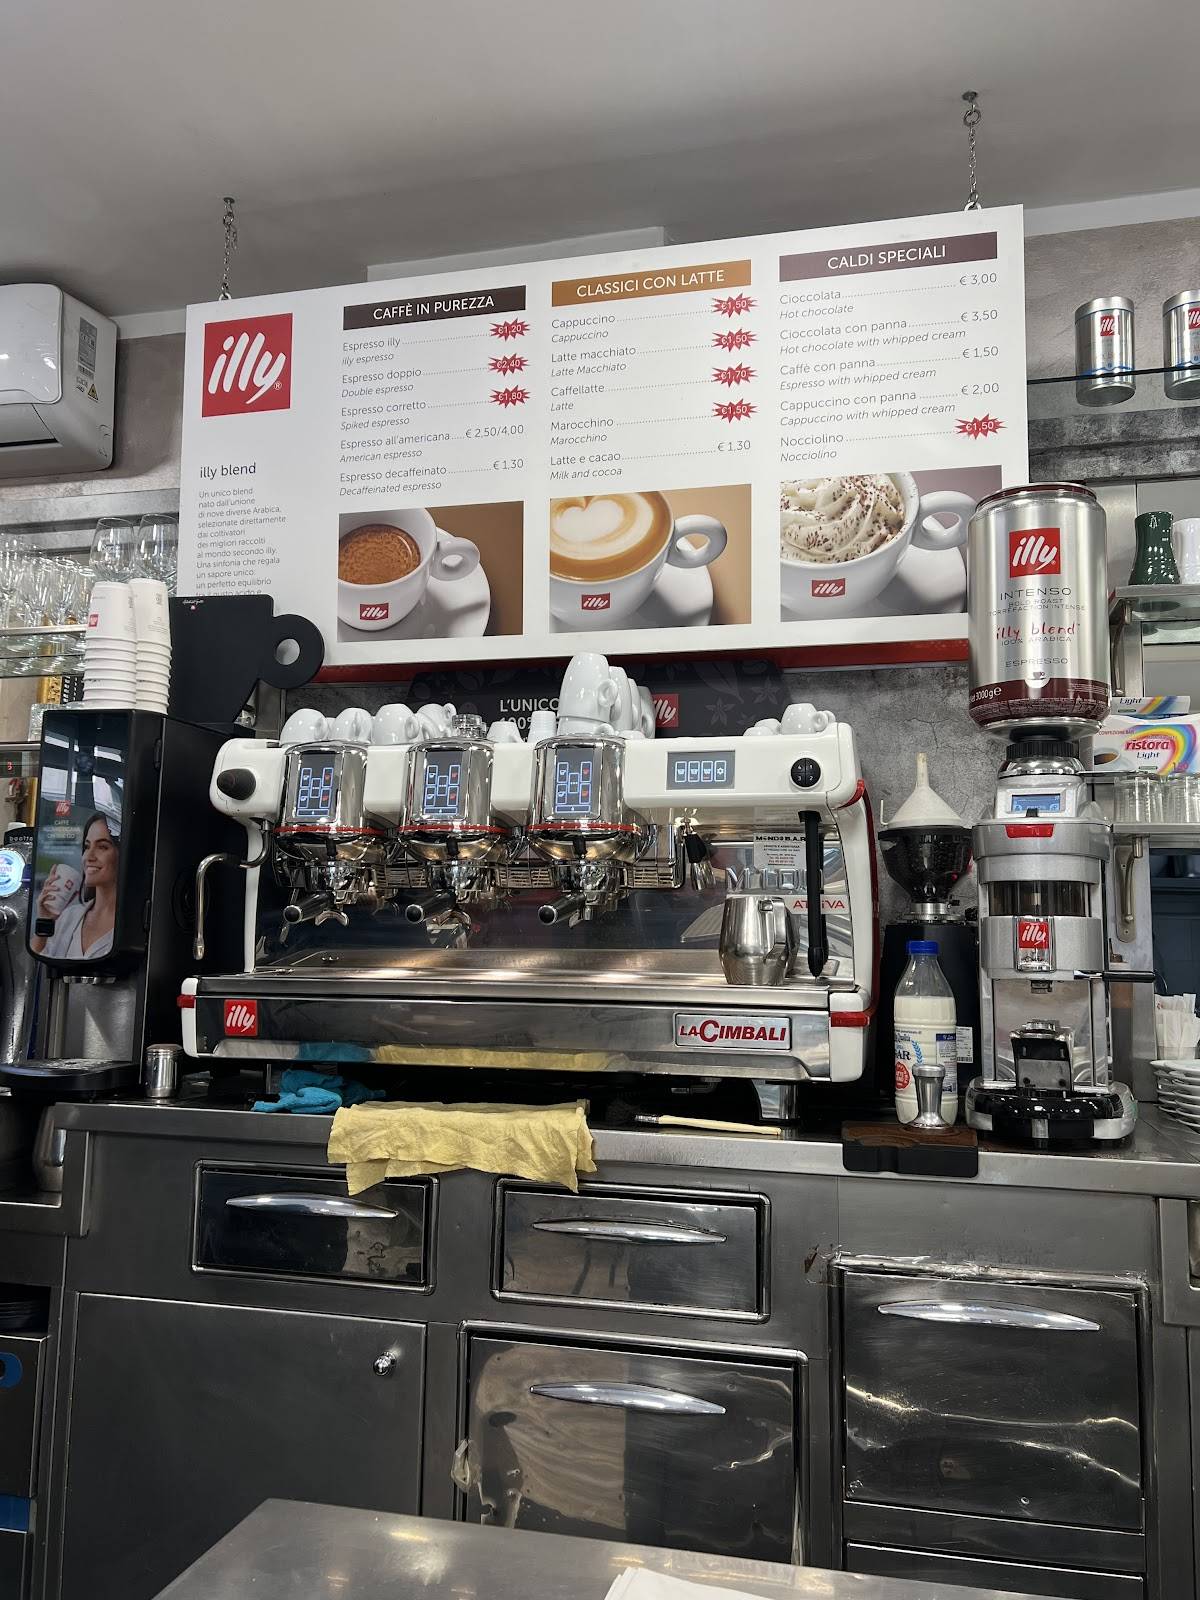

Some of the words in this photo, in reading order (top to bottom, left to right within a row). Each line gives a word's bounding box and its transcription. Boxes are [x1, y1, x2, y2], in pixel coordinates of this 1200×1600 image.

[828, 253, 873, 269] CALDI
[878, 245, 945, 264] SPECIALI
[577, 279, 638, 297] CLASSICI
[643, 275, 676, 290] CON
[681, 269, 725, 286] LATTE
[779, 291, 841, 305] Cioccolata
[971, 272, 997, 286] 3,00
[373, 303, 412, 320] CAFFÈ
[417, 303, 429, 315] IN
[434, 296, 494, 313] PUREZZA
[779, 310, 799, 320] Hot
[801, 304, 855, 318] chocolate
[551, 315, 616, 329] Cappuccino
[780, 326, 841, 340] Cioccolata
[845, 324, 867, 334] con
[871, 320, 907, 333] panna
[972, 309, 998, 322] 3,50
[343, 340, 385, 353] Espresso
[387, 337, 401, 348] illy
[551, 330, 609, 344] Cappuccino
[780, 345, 799, 355] Hot
[801, 341, 854, 353] chocolate
[857, 337, 880, 347] with
[883, 332, 929, 345] whipped
[931, 330, 966, 341] cream
[342, 356, 354, 367] illy
[356, 353, 394, 365] espresso
[551, 353, 577, 363] Latte
[580, 347, 636, 360] macchiato
[780, 363, 811, 376] Caffè
[813, 363, 836, 373] con
[839, 359, 875, 372] panna
[974, 346, 999, 358] 1,50
[208, 332, 286, 404] illy
[551, 368, 574, 377] Latte
[576, 362, 627, 375] Macchiato
[342, 373, 384, 385] Espresso
[386, 368, 422, 380] doppio
[780, 379, 826, 392] Espresso
[828, 376, 851, 386] with
[853, 370, 900, 384] whipped
[902, 369, 937, 379] cream
[341, 387, 374, 398] Double
[375, 384, 414, 396] espresso
[550, 384, 605, 397] Caffellatte
[780, 397, 851, 412] Cappuccino
[853, 395, 876, 405] con
[880, 392, 917, 405] panna
[972, 382, 1000, 395] 2,00
[341, 406, 384, 418] Espresso
[386, 401, 426, 413] corretto
[550, 402, 574, 412] Latte
[780, 414, 843, 427] Cappuccino
[846, 410, 869, 420] with
[872, 405, 919, 419] whipped
[921, 404, 955, 414] cream
[340, 419, 369, 431] Spiked
[371, 417, 410, 429] espresso
[550, 418, 614, 431] Marocchino
[340, 439, 383, 451] Espresso
[385, 433, 450, 446] all'americana
[474, 424, 524, 438] 2,50/4,00
[550, 433, 608, 445] Marocchino
[780, 433, 844, 447] Nocciolino
[339, 453, 381, 463] American
[383, 450, 423, 461] espresso
[550, 456, 576, 466] Latte
[579, 456, 586, 464] e
[588, 453, 621, 463] cacao
[728, 440, 751, 452] 1,30
[780, 450, 837, 462] Nocciolino
[200, 466, 217, 480] illy
[221, 462, 256, 476] blend
[340, 472, 383, 484] Espresso
[385, 466, 447, 479] decaffeinato
[502, 458, 524, 470] 1,30
[550, 470, 569, 480] Milk
[571, 469, 590, 479] and
[593, 468, 622, 477] cocoa
[339, 483, 401, 496] Decaffeinated
[402, 482, 442, 492] espresso
[1012, 535, 1058, 571] illy
[814, 583, 843, 596] illy
[1000, 587, 1072, 600] INTENSO
[583, 595, 609, 609] illy
[361, 606, 386, 620] illy
[996, 624, 1020, 640] illy
[1031, 621, 1075, 635] blend
[1005, 657, 1069, 667] ESPRESSO
[1119, 697, 1142, 705] Light
[1125, 739, 1169, 750] ristora
[1137, 751, 1160, 760] Light
[1022, 925, 1046, 946] illy
[226, 1004, 256, 1033] illy
